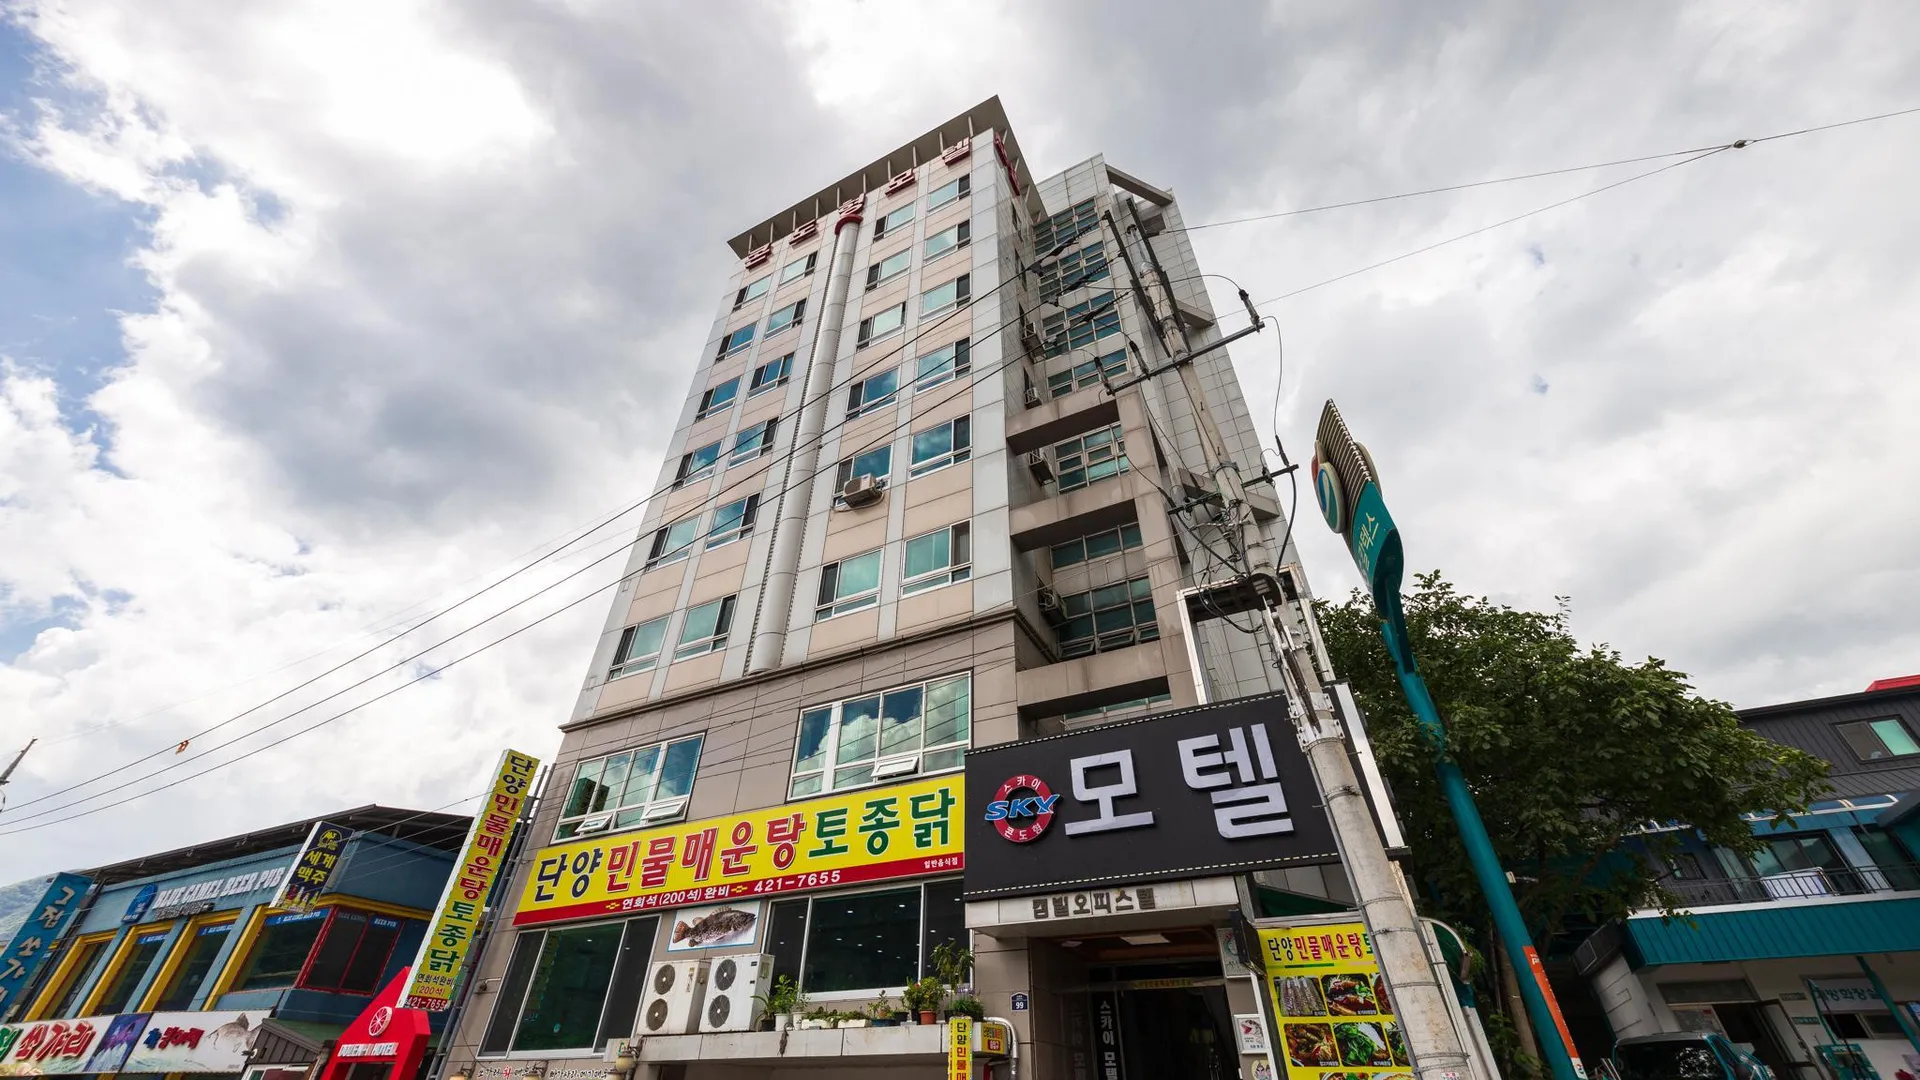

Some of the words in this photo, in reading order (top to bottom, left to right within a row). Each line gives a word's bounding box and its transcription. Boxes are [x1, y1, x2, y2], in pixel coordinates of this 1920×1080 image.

[1004, 776, 1041, 794] 스카이
[1065, 723, 1295, 839] 모텔
[984, 794, 1060, 820] SKY
[1004, 822, 1043, 840] 콘도형
[305, 851, 337, 869] 세계
[924, 857, 958, 869] 일반음식점
[298, 866, 327, 884] 맥주
[754, 870, 841, 893] 421-7655
[152, 887, 187, 909] BLUE
[182, 879, 224, 903] CAMEL
[220, 872, 259, 897] BEER
[254, 867, 286, 890] PUB
[1100, 1001, 1114, 1045] 스카이
